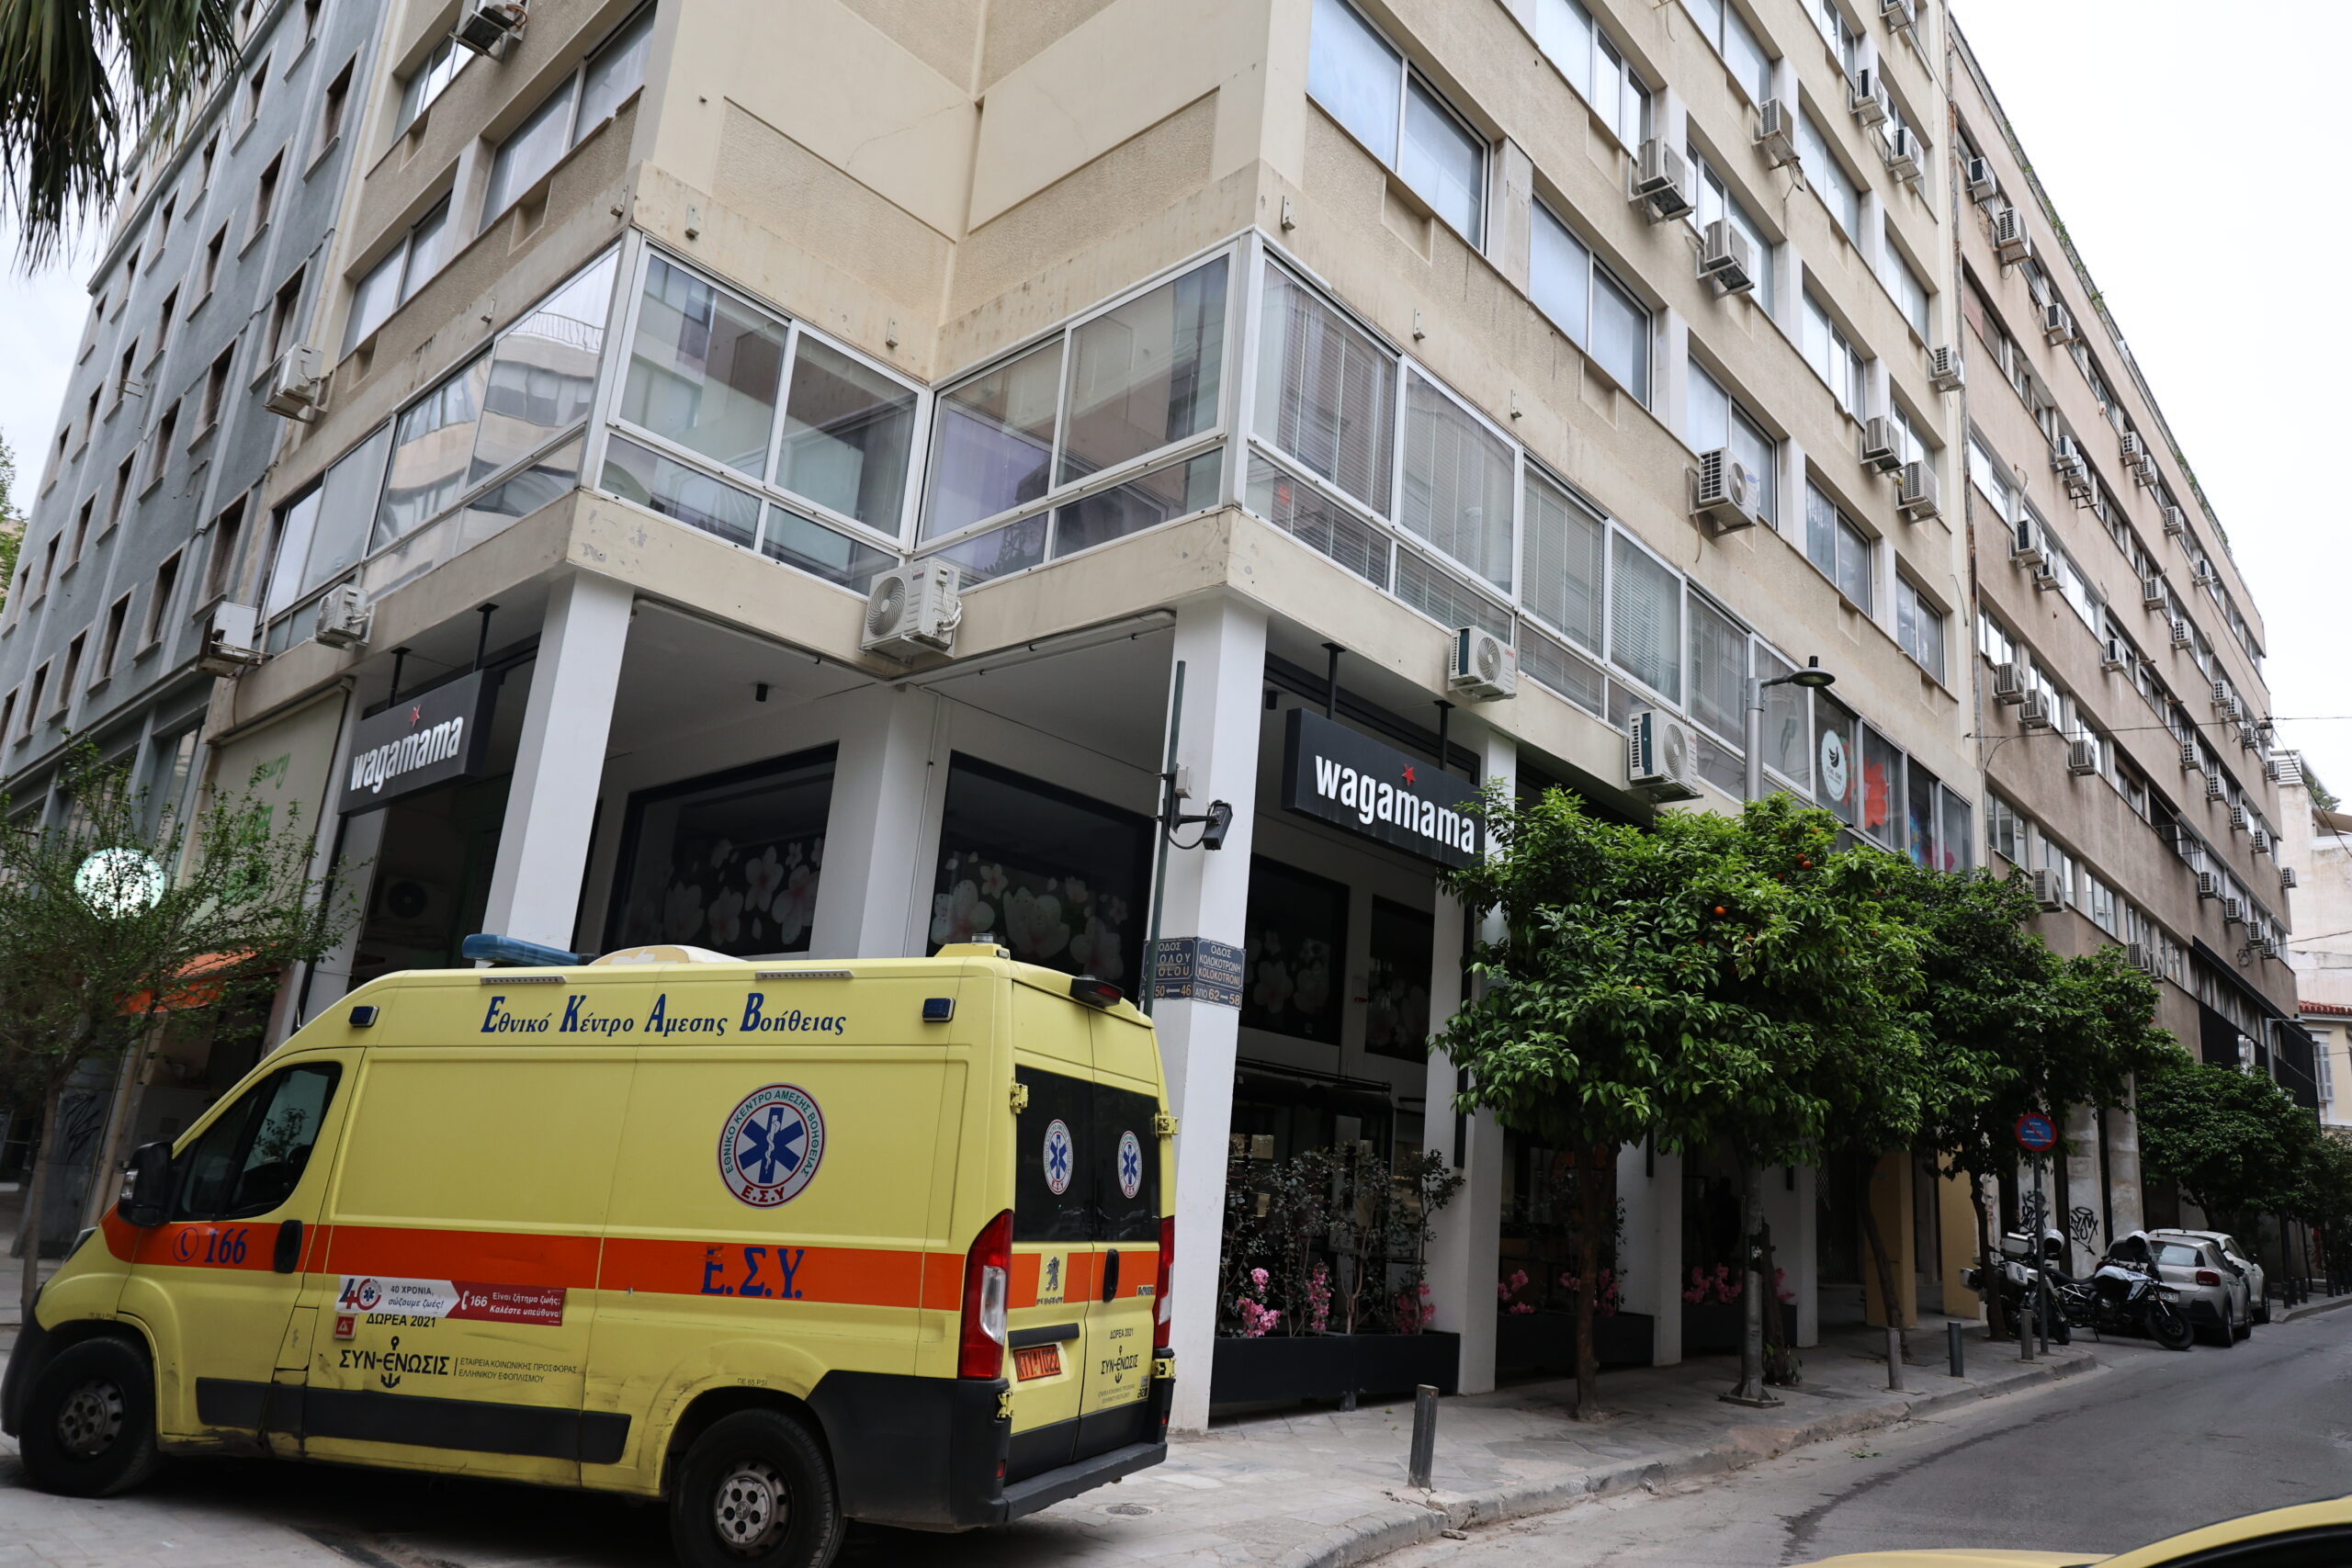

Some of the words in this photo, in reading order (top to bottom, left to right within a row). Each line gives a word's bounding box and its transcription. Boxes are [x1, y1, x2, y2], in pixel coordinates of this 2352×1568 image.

[350, 716, 464, 794] wagamama
[1315, 755, 1475, 854] wagamama
[1159, 942, 1182, 952] ΟΔΟΣ
[1210, 945, 1232, 958] ΟΔΟΣ
[1147, 953, 1192, 964] ΟΛΟΥ
[1199, 953, 1241, 974] ΚΟΛΟΚΟΤΡΩΝΗ
[1146, 965, 1190, 977] OLOU
[1198, 966, 1240, 986] KOLOKOTRONI
[1155, 985, 1166, 997] 50
[1181, 984, 1192, 996] 46
[1195, 988, 1207, 998] ΑΠΟ
[1208, 989, 1220, 1001] 62
[1228, 993, 1240, 1006] 58
[481, 996, 552, 1033] Εθνικό
[559, 995, 634, 1036] Κέντρο
[644, 993, 729, 1037] Αμεσης
[740, 992, 847, 1034] Βοήθειας
[724, 1126, 736, 1174] ΕΘΝΙΚΟ
[733, 1091, 772, 1124] ΚΕΝΤΡΟ
[774, 1089, 811, 1113] ΑΜΕΣΗΣ
[800, 1111, 820, 1178] ΒΟΗΘΕΙΑΣ
[204, 1228, 249, 1264] 166
[390, 1285, 400, 1294] 40
[401, 1286, 435, 1296] ΧΡΟΝΙΑ,
[388, 1297, 423, 1310] σώζουμε
[423, 1298, 445, 1310] ζωές!
[470, 1295, 488, 1307] 166
[492, 1292, 512, 1301] Είναι
[513, 1293, 538, 1305] ζήτημα
[490, 1303, 522, 1315] Καλέστε
[366, 1314, 407, 1327] ΔΩΡΕΑ
[410, 1315, 436, 1328] 2021
[339, 1349, 450, 1376] ΣΥΝ-ΕΝΩΣΙΣ
[460, 1357, 490, 1368] ΕΤΑΙΡΕΙΑ
[491, 1359, 532, 1371] ΚΟΙΝΩΝΙΚΗΣ
[533, 1361, 577, 1374] ΠΡΟΣΦΟΡΑΣ
[458, 1369, 497, 1380] ΕΛΛΗΝΙΚΟΥ
[498, 1371, 545, 1383] ΕΦΟΠΛΙΣΜΟΥ
